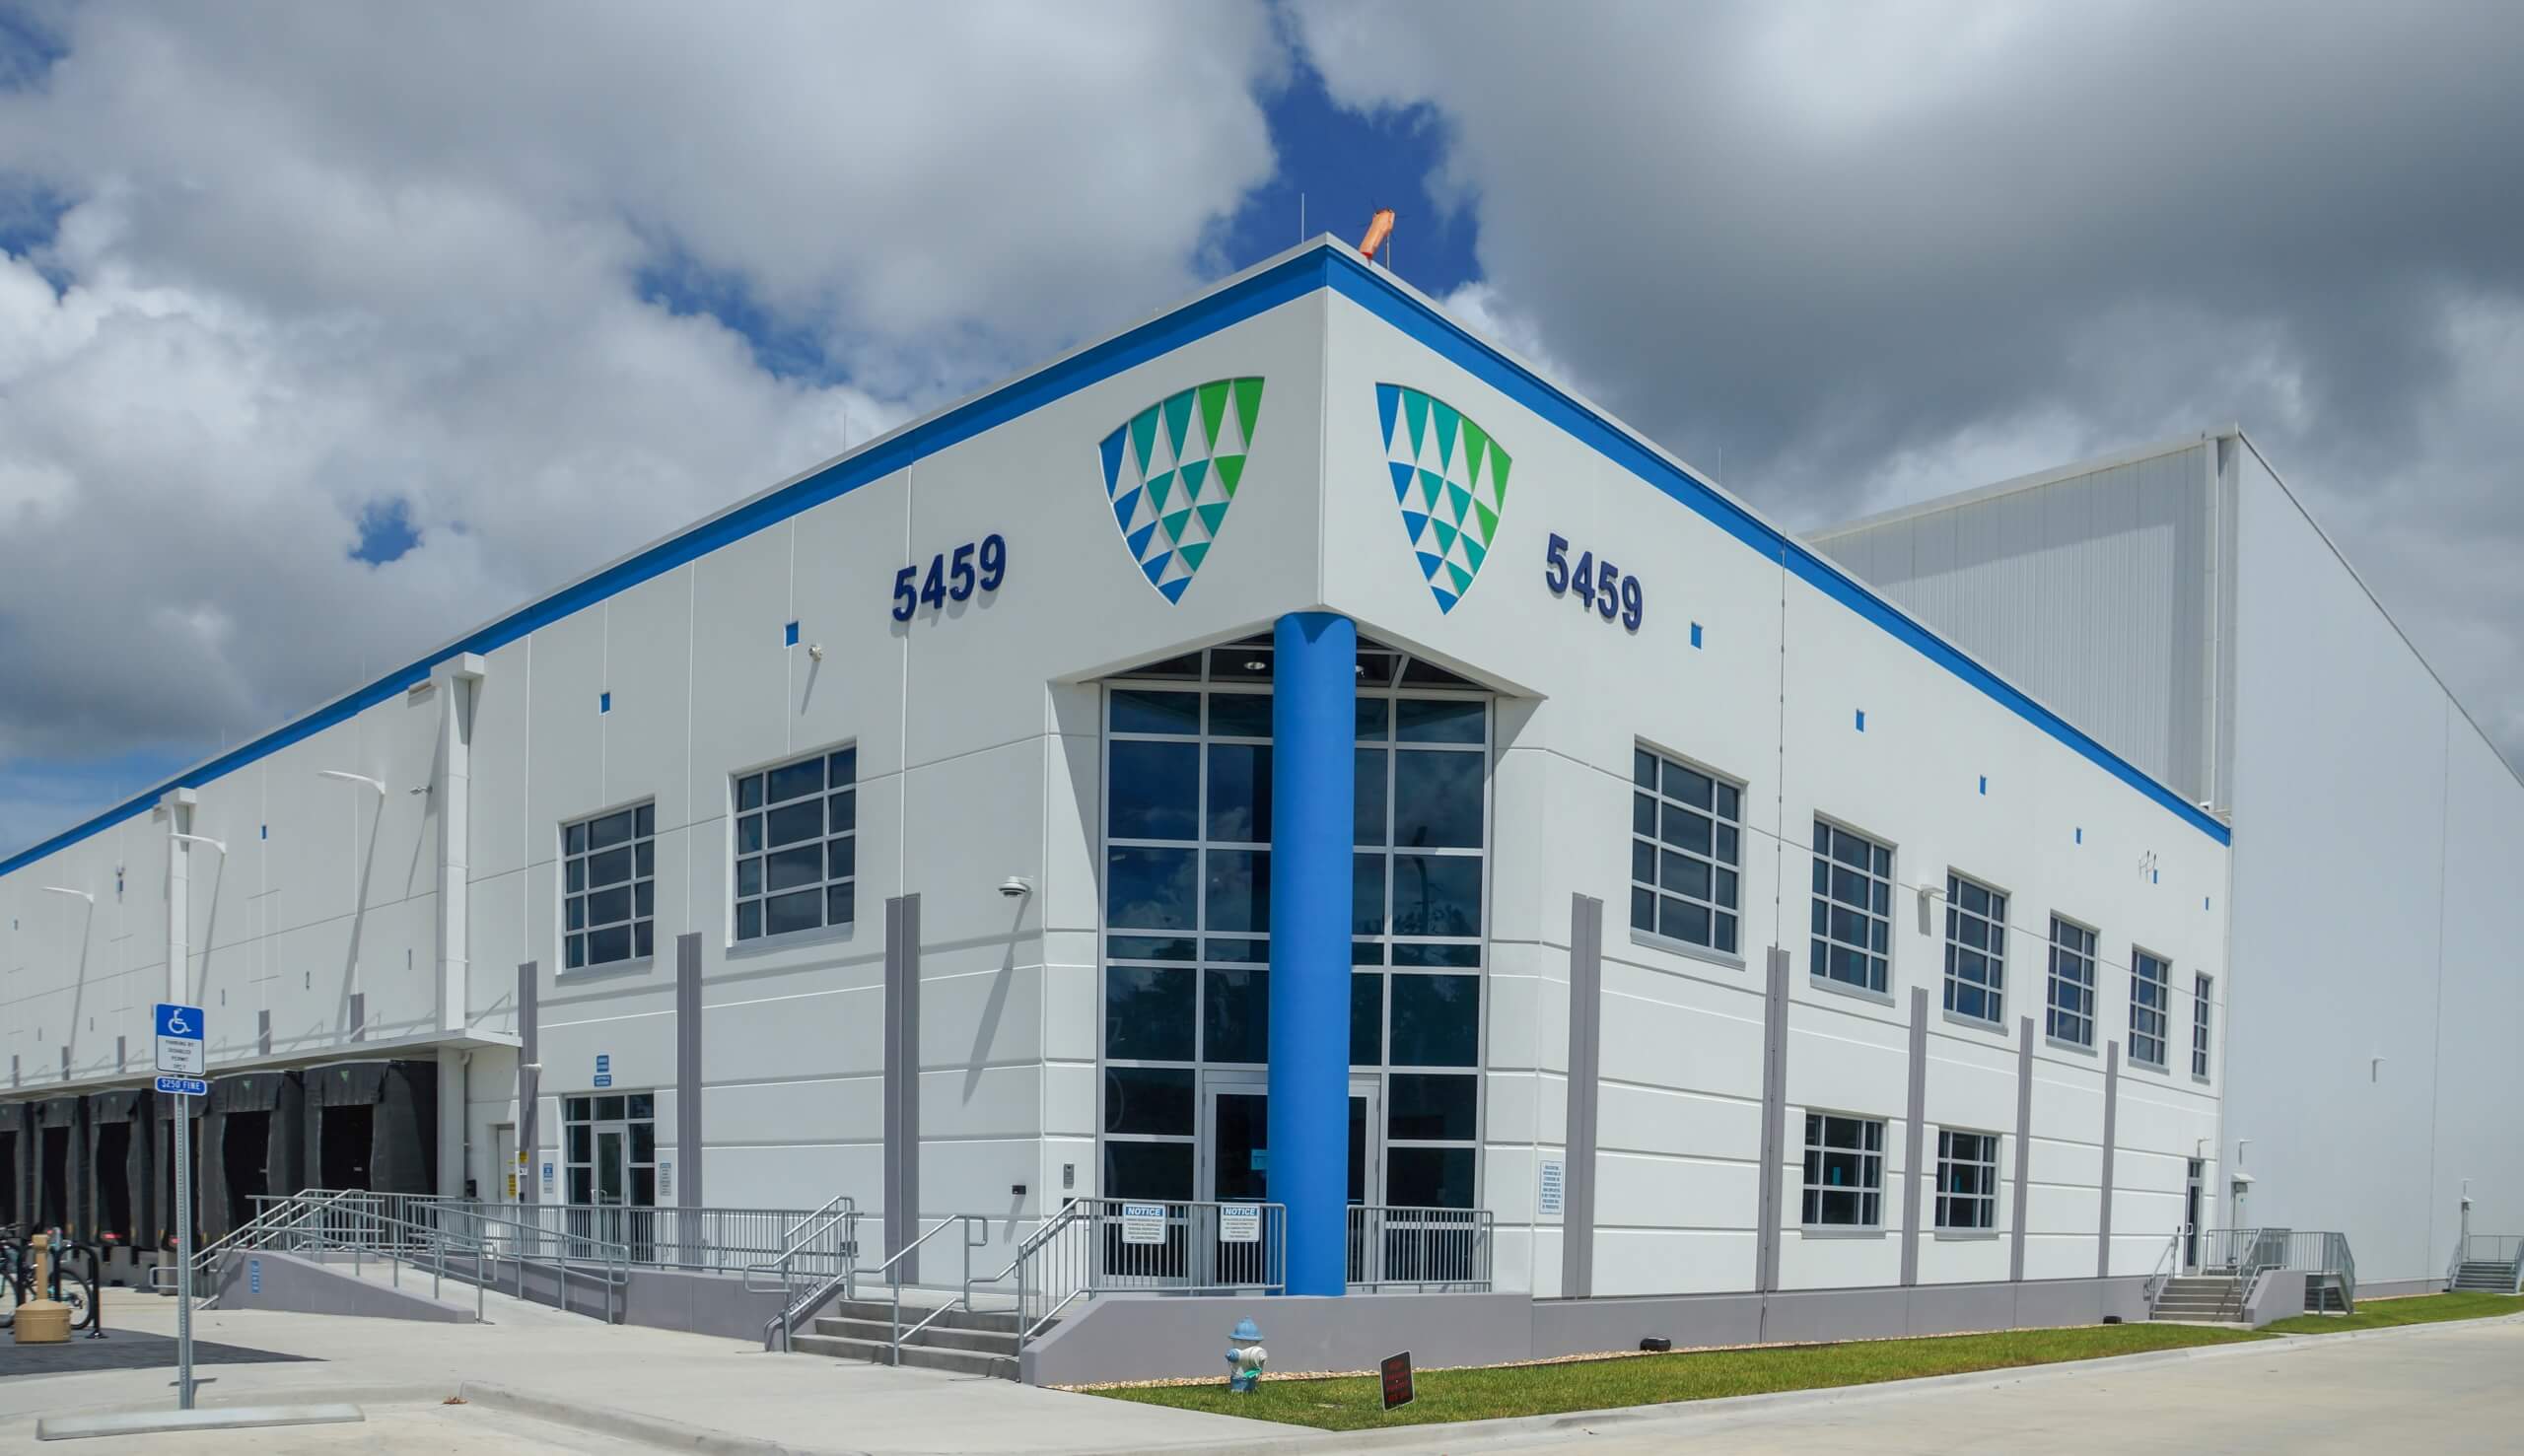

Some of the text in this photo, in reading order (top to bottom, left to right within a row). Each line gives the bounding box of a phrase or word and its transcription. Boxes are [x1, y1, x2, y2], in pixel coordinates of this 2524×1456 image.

[892, 533, 1007, 622] 5459
[1546, 532, 1643, 632] 5459
[161, 1078, 201, 1090] $250 FINE
[1127, 1207, 1161, 1216] NOTICE
